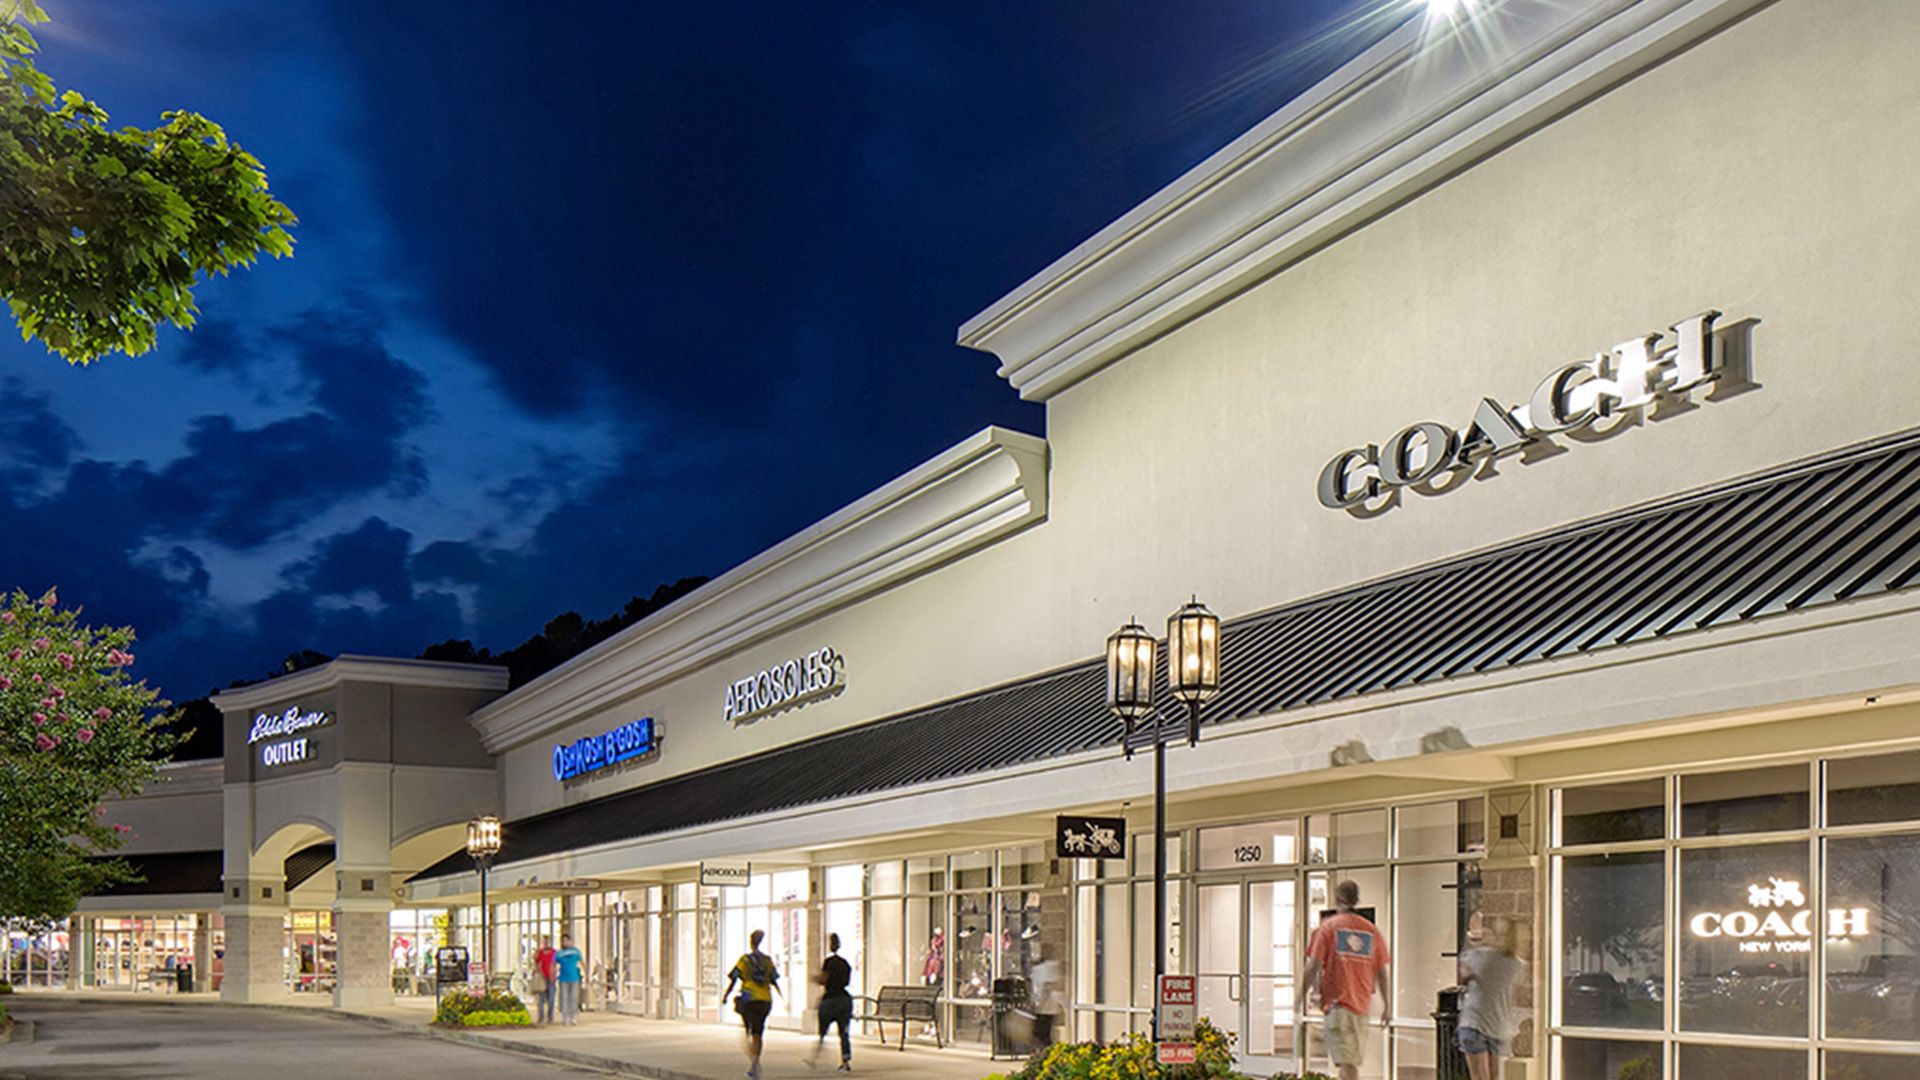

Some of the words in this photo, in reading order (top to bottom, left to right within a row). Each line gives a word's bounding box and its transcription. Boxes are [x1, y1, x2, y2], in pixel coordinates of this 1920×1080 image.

[1317, 309, 1722, 509] COACH
[722, 646, 835, 721] AEROSOLES
[263, 738, 308, 766] OUTLET
[1234, 845, 1261, 862] 1250
[1690, 907, 1870, 937] COACH
[1739, 941, 1771, 952] NEW
[1166, 979, 1191, 990] FIRE
[1163, 992, 1193, 1002] LANE
[1172, 1010, 1184, 1019] NO
